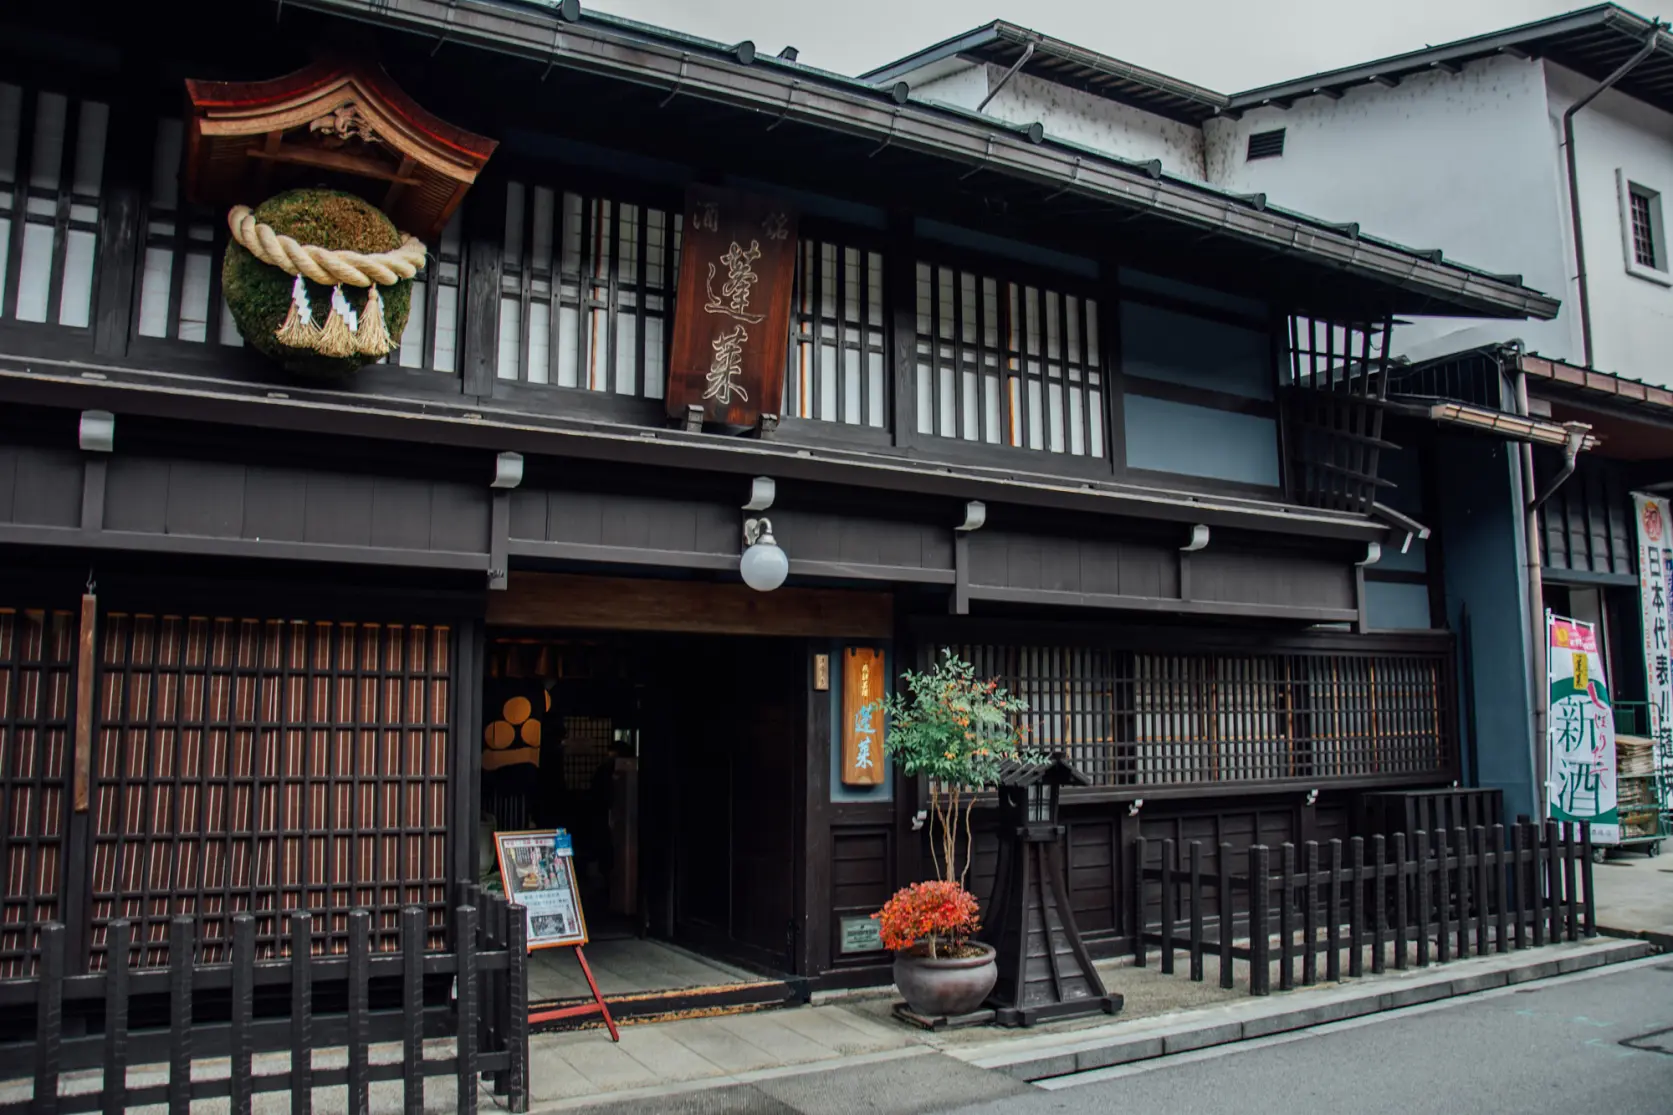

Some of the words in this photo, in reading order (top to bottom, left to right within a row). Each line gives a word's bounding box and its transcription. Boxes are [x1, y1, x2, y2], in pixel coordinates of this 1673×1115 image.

[702, 239, 767, 405] 蓬莱
[855, 704, 876, 769] 蓬莱
[1556, 696, 1600, 815] 新酒
[1587, 681, 1608, 790] しぼりたて
